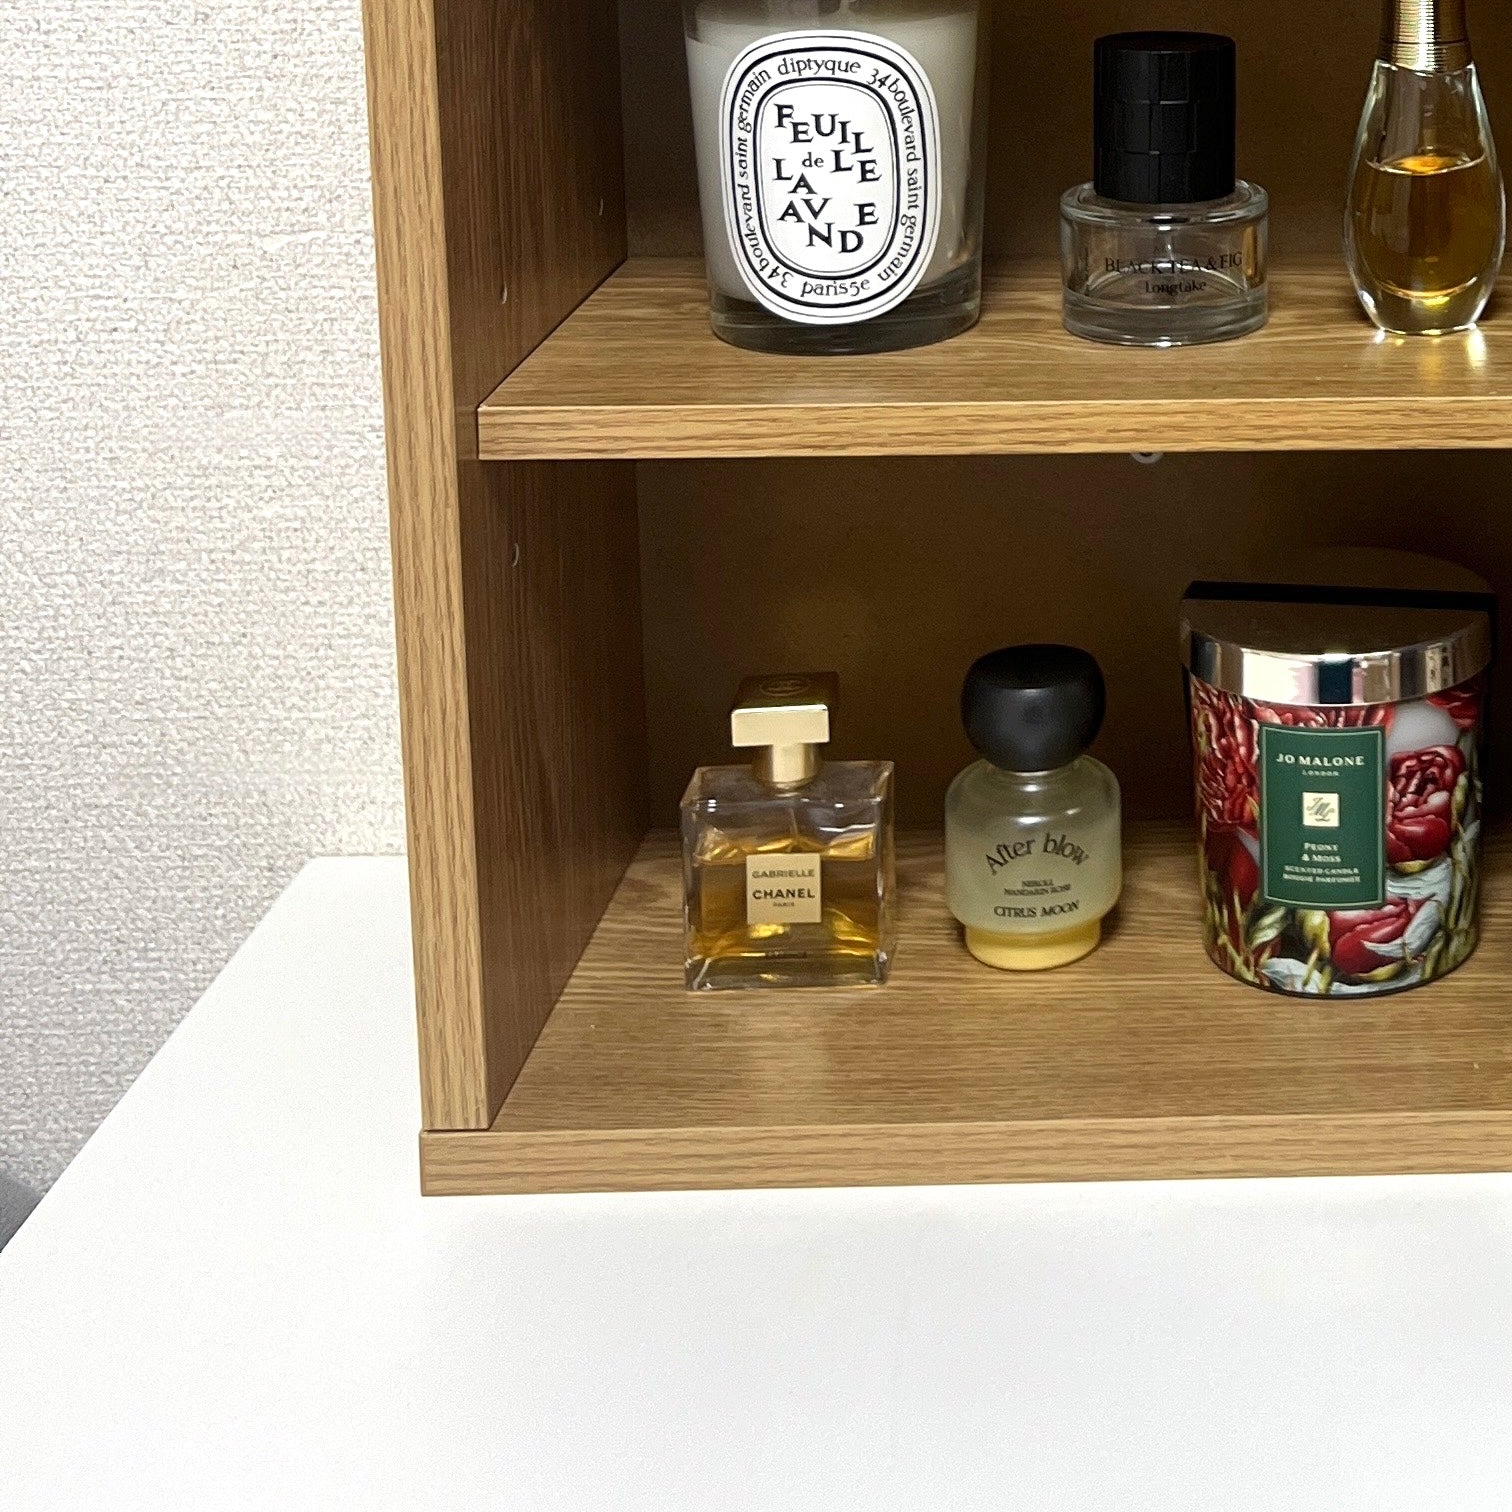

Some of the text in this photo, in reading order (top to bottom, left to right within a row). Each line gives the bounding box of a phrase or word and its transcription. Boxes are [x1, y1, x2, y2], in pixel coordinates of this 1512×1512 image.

[777, 57, 862, 76] diptyque
[737, 69, 772, 134] germain
[735, 136, 748, 180] saint
[801, 151, 825, 168] de
[906, 168, 923, 210] saint
[877, 214, 917, 281] germain
[1105, 257, 1163, 274] BLACK
[1167, 259, 1201, 274] TEA
[1219, 251, 1243, 269] FIG
[1145, 279, 1207, 296] Longtake
[1276, 753, 1365, 766] JO MALONE
[986, 832, 1090, 876] After blow
[752, 869, 815, 879] GABRIELLE
[752, 888, 816, 900] CHANEL
[993, 900, 1080, 918] CITRUS MOON
